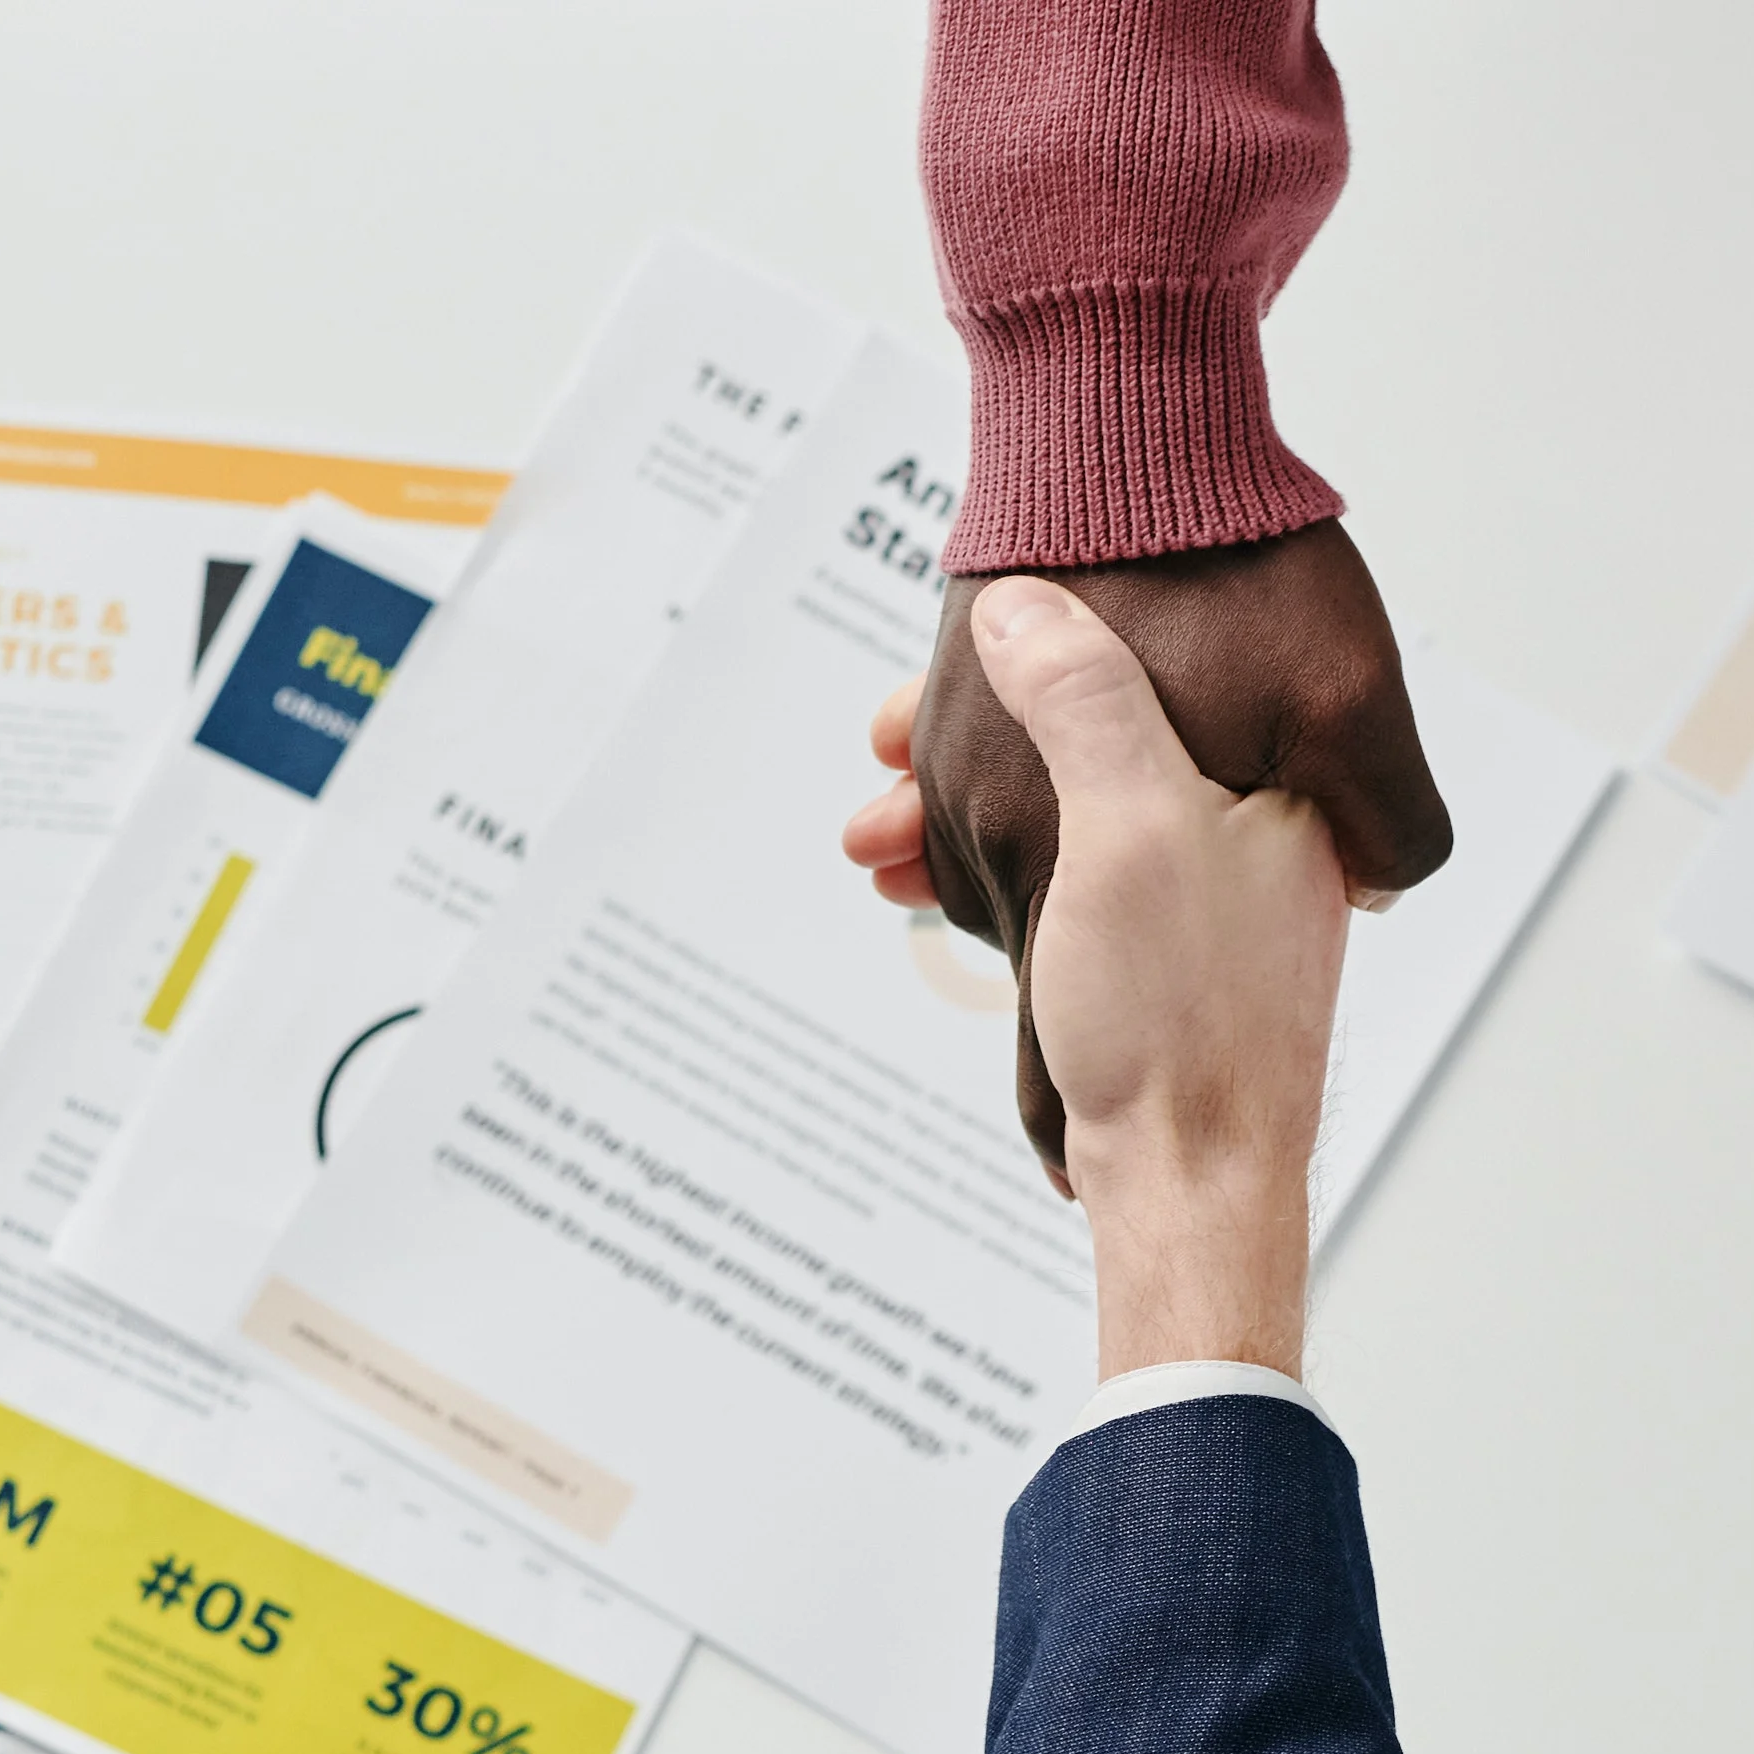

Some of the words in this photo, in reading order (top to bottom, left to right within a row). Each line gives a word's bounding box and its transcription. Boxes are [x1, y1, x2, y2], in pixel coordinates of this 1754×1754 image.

[874, 451, 955, 518] An
[843, 505, 947, 592] Sta
[99, 599, 129, 637] &
[140, 1557, 292, 1656] #05
